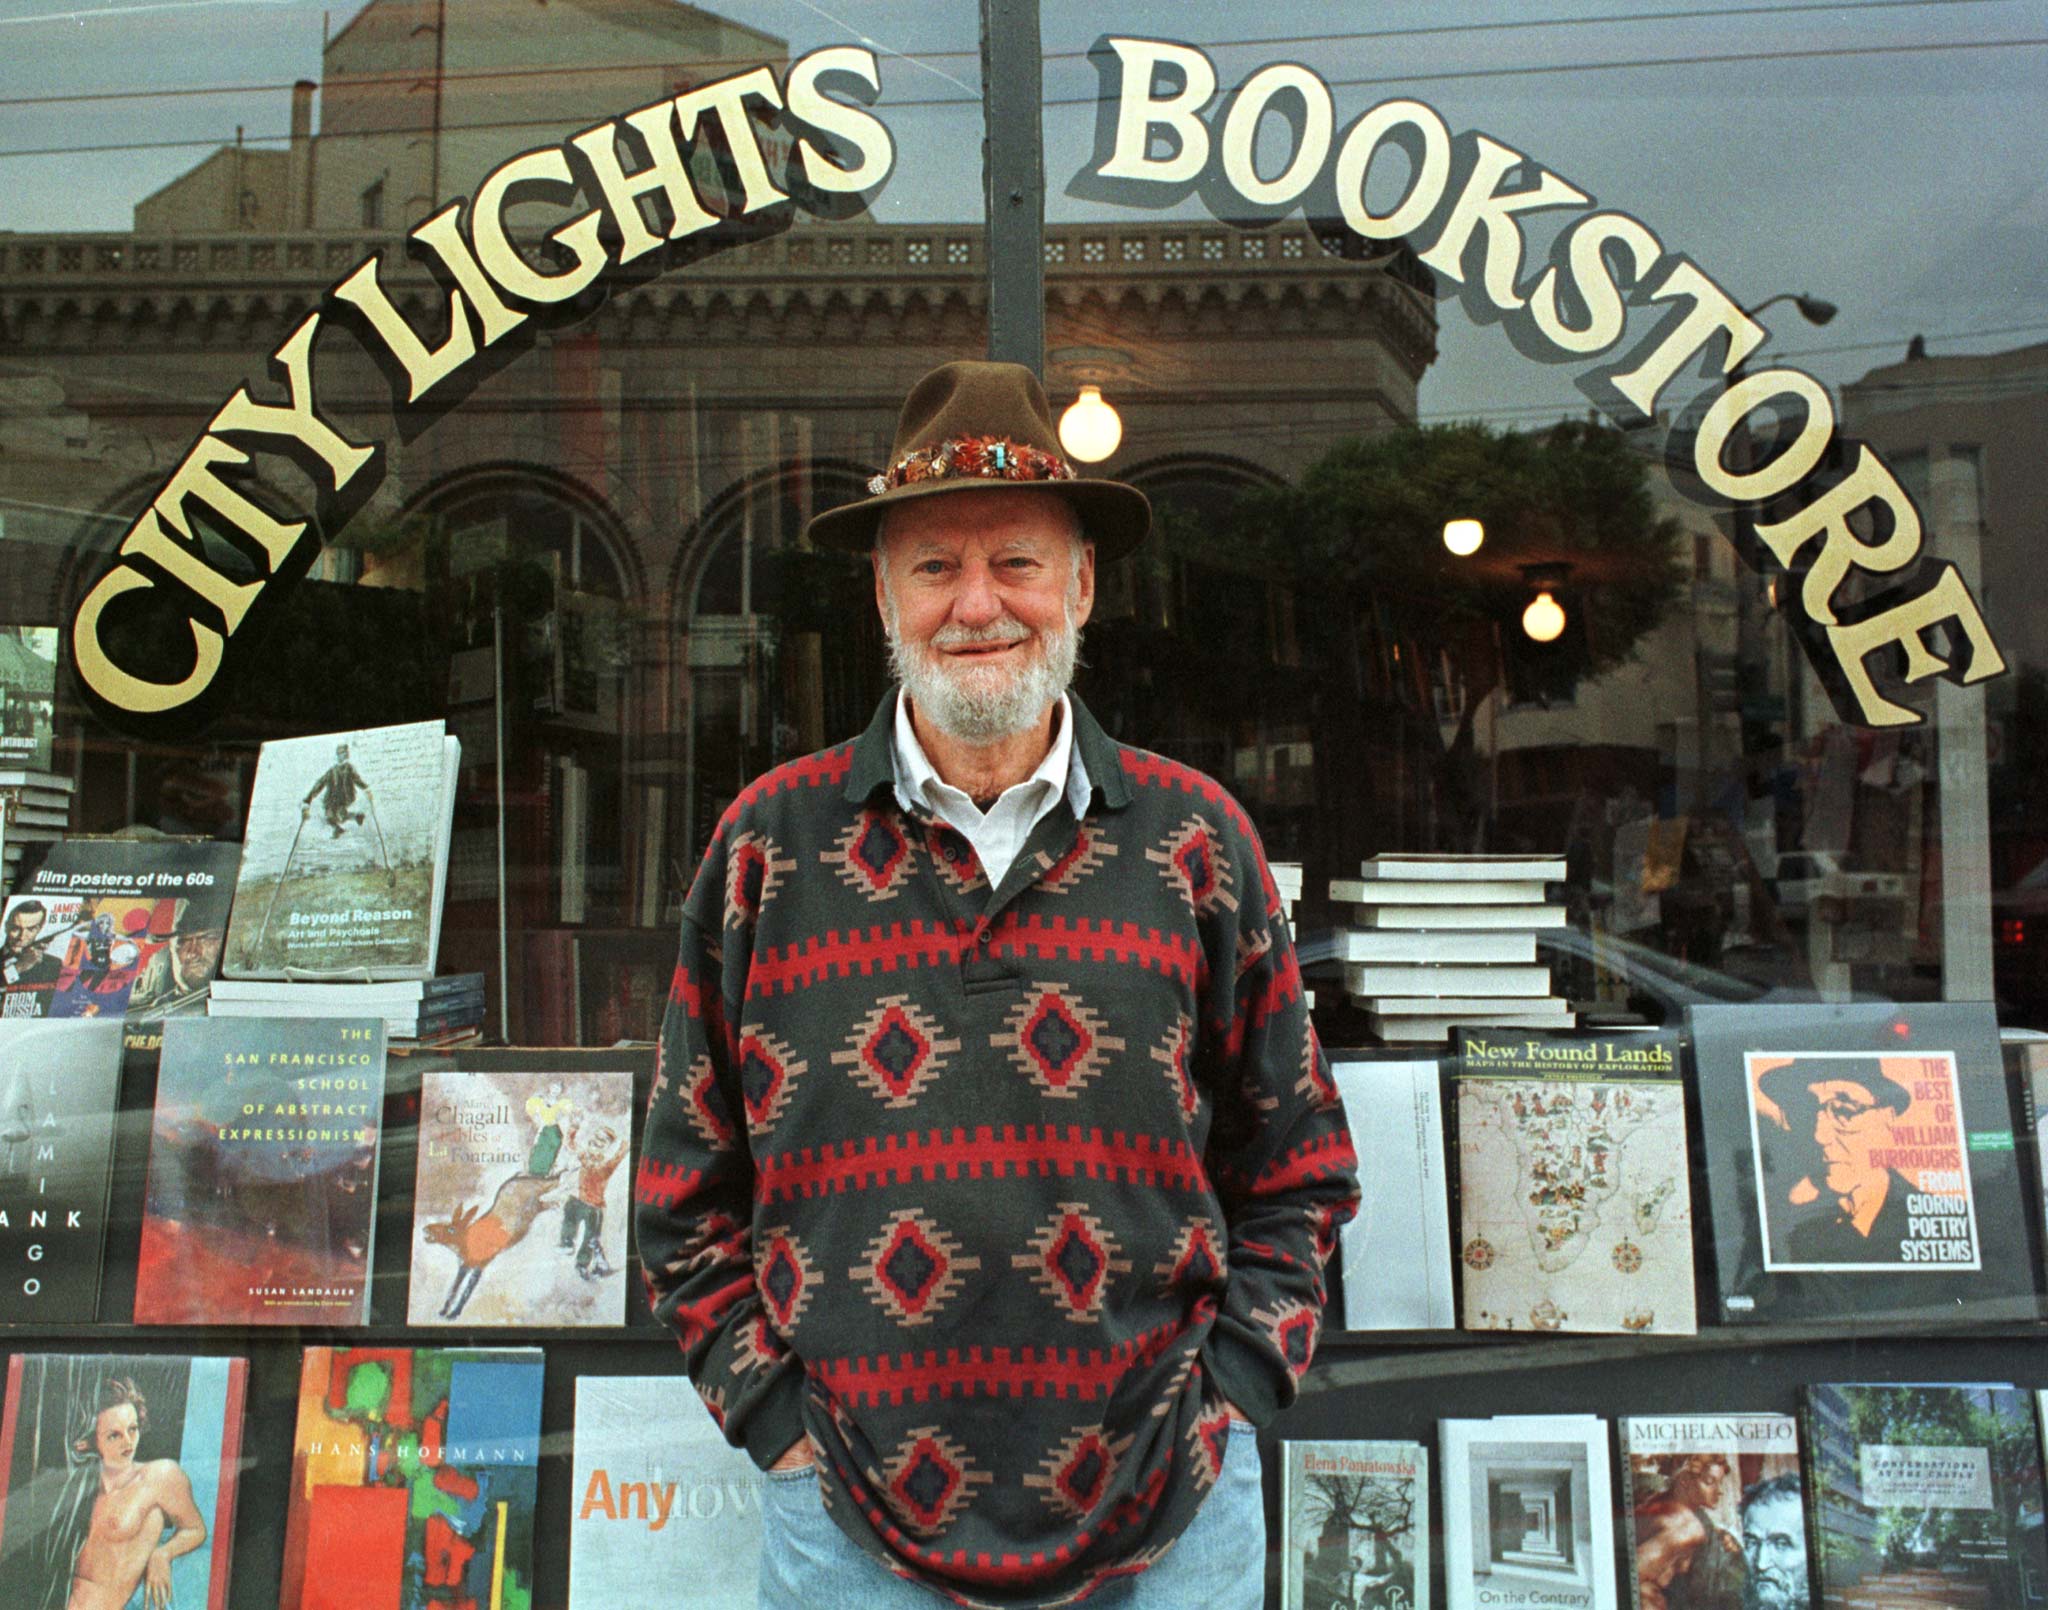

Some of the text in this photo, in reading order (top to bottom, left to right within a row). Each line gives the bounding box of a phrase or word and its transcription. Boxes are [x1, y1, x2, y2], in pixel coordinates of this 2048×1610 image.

[73, 46, 896, 714] CITY LIGHTS
[1096, 37, 2006, 728] BOOKSTORE
[36, 870, 214, 889] film posters of the 60s
[289, 908, 412, 927] Beyond Reason
[288, 926, 380, 939] Art and Psychosis
[340, 1028, 372, 1041] THE
[225, 1053, 371, 1066] SAN FRANCISCO
[1465, 1040, 1673, 1063] New Found Lands
[1465, 1060, 1495, 1068] MAPS
[1511, 1061, 1531, 1069] THE
[1534, 1062, 1580, 1070] HISTORY
[1581, 1063, 1594, 1071] OF
[1598, 1063, 1673, 1072] EXPLORATION
[1919, 1058, 1949, 1078] THE
[298, 1078, 369, 1091] SCHOOL
[1914, 1081, 1950, 1101] BEST
[242, 1103, 368, 1116] OF ABSTRACT
[435, 1104, 509, 1131] Chagall
[1934, 1104, 1953, 1123] OF
[218, 1128, 366, 1141] EXPRESSIONISM
[1892, 1126, 1956, 1146] WILLIAM
[451, 1145, 521, 1164] Fontaine
[1869, 1149, 1961, 1169] BURROUGHS
[1918, 1170, 1962, 1191] FROM
[1906, 1193, 1966, 1215] GIORNO
[1908, 1216, 1969, 1239] POETRY
[1900, 1239, 1972, 1262] SYSTEMS
[248, 1287, 354, 1296] SUSAN LANDAUER
[1634, 1422, 1792, 1441] MICHELANGELO
[310, 1441, 525, 1462] HANS HOFMANN
[1304, 1453, 1337, 1471] Elena
[1480, 1590, 1590, 1606] On the Contrary
